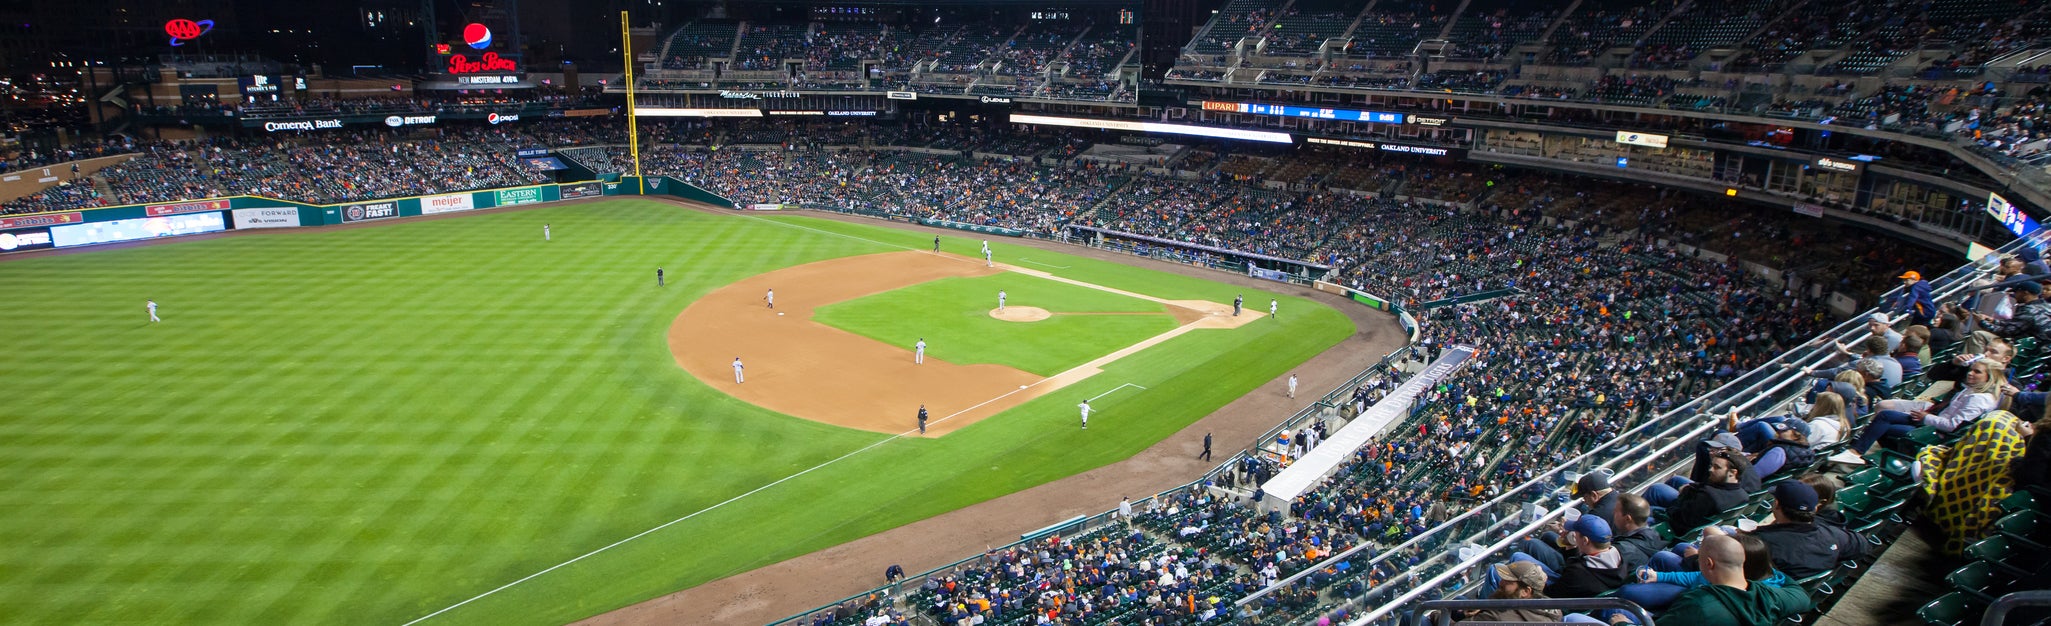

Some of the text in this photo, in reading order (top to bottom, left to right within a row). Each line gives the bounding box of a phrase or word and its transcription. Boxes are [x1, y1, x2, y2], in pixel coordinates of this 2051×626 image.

[1207, 102, 1235, 111] LIPARI
[404, 115, 436, 125] DETROIT
[499, 114, 519, 122] pepsi
[1417, 117, 1447, 125] DETROIT
[315, 119, 343, 129] Bank
[1381, 144, 1447, 156] OAKLAND UNIVERSITY
[500, 189, 537, 199] EASTERN
[432, 195, 463, 207] meijer
